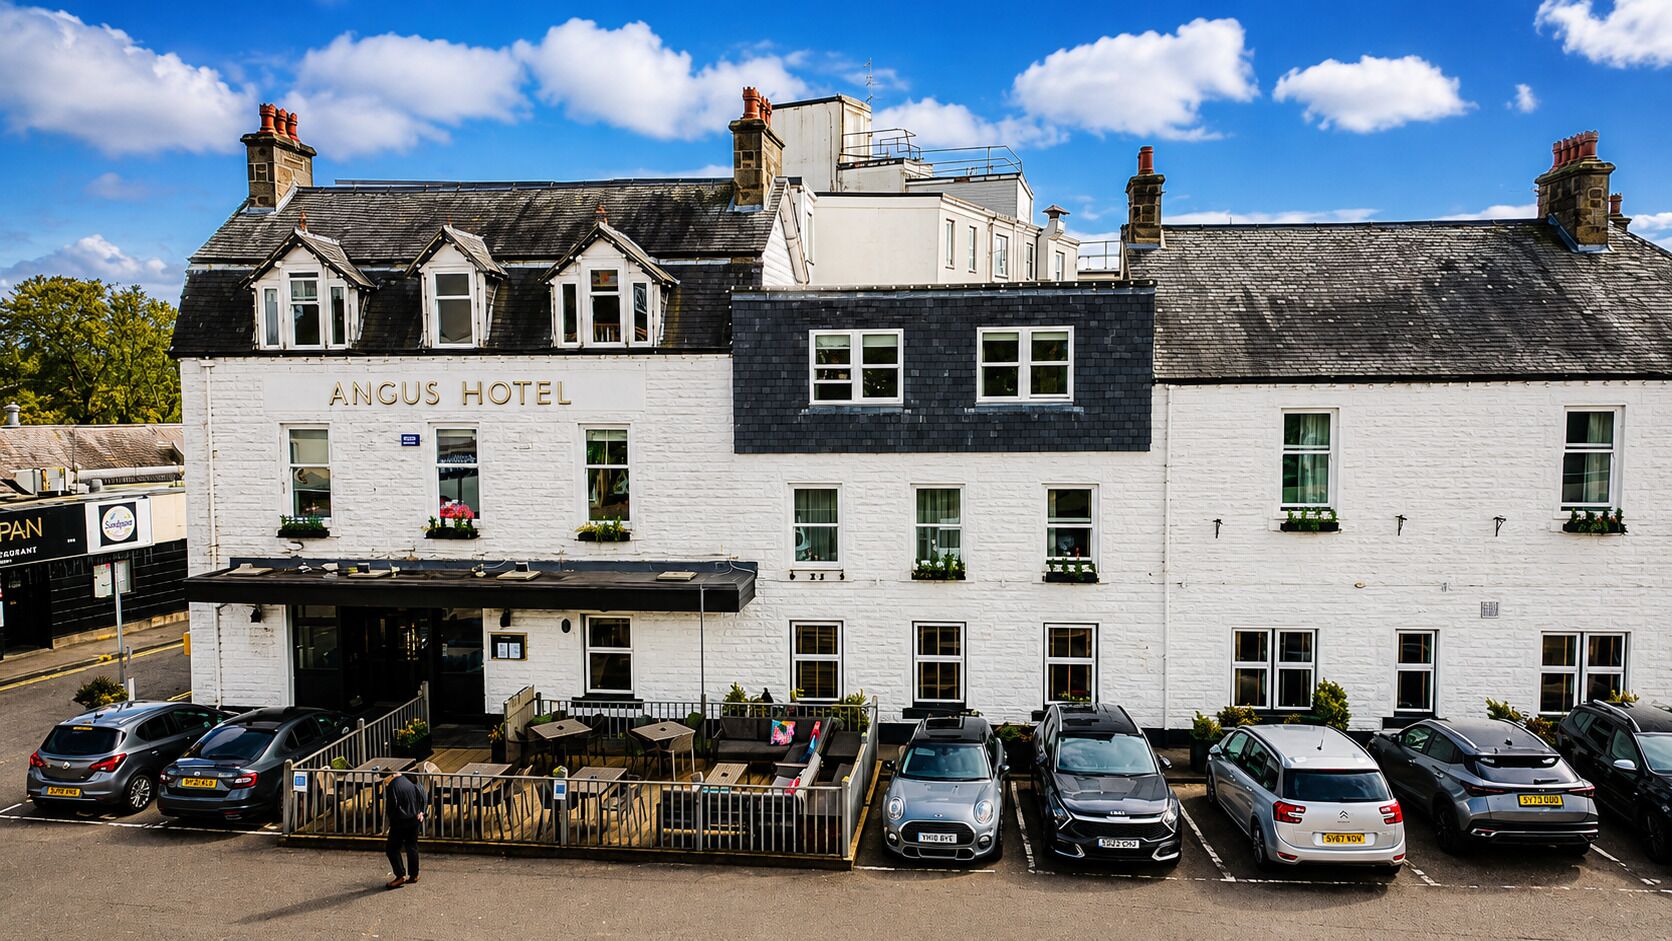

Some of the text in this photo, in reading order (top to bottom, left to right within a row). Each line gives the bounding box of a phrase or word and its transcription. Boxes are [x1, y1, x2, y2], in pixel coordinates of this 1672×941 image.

[329, 381, 572, 405] ANGUS HOTEL
[1326, 834, 1344, 843] SY67
